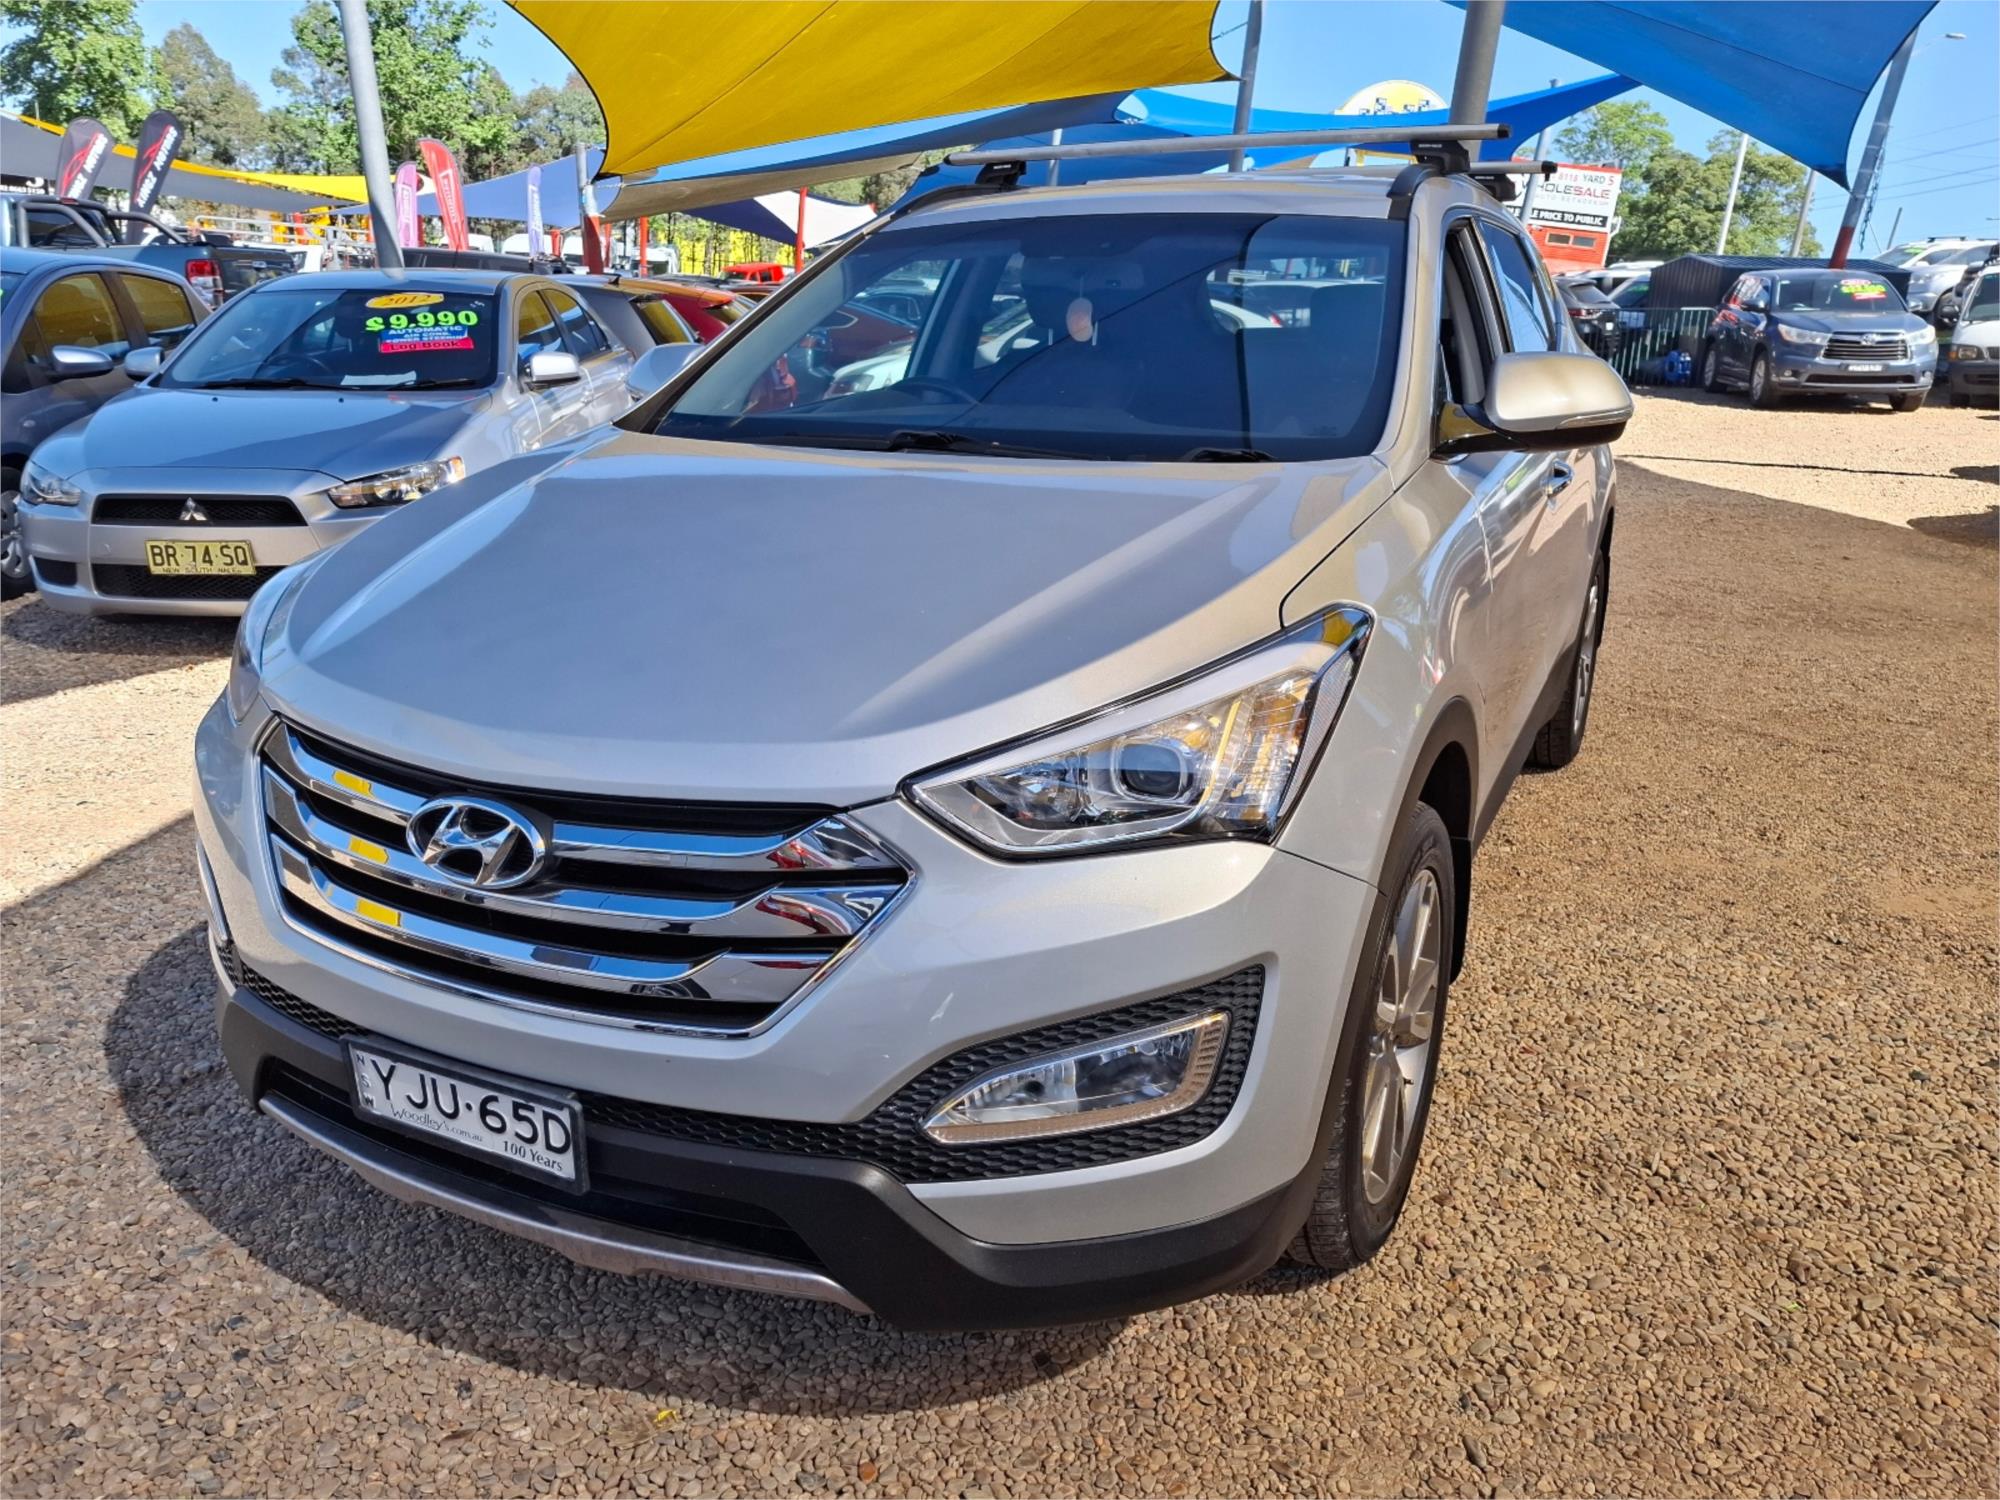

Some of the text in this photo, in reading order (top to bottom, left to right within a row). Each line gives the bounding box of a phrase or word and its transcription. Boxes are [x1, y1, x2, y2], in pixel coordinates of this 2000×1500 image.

[1583, 173, 1606, 184] YARD
[1537, 183, 1611, 199] HOLESALE
[1540, 210, 1562, 220] PRICE
[1563, 212, 1574, 221] TO
[1575, 213, 1604, 225] PUBLIC
[388, 325, 463, 335] AUTOMATIC
[391, 340, 460, 351] Log Book
[503, 1140, 563, 1172] 100 Years
